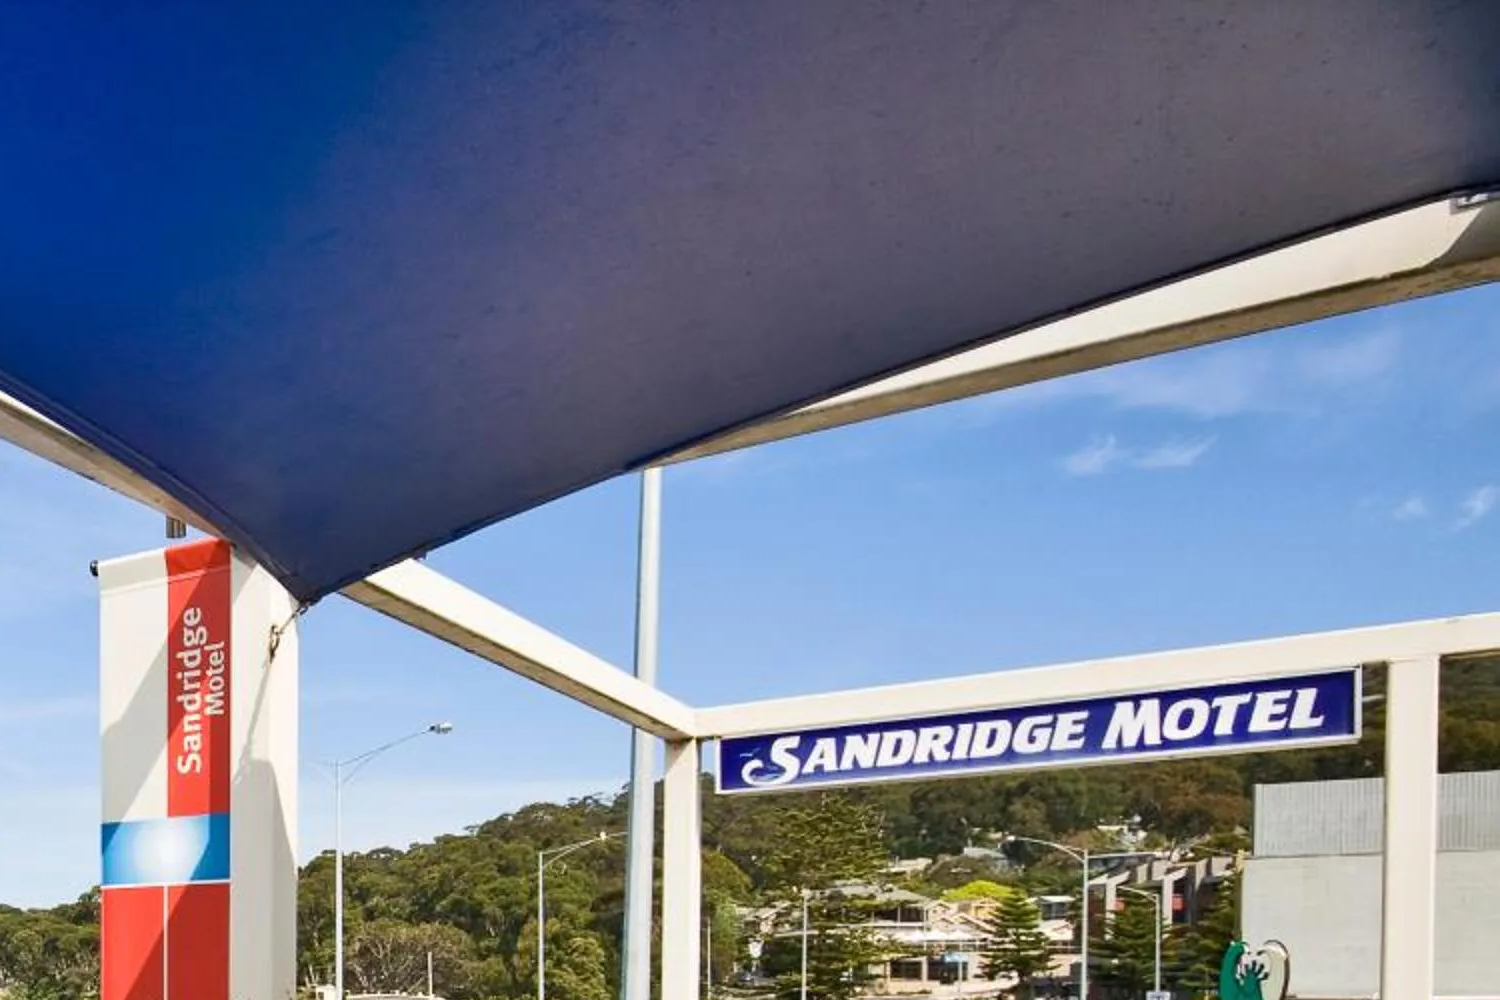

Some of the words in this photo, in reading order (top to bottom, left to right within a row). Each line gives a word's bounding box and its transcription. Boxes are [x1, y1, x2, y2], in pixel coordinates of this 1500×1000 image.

[176, 607, 208, 774] Sandridge
[204, 640, 225, 716] Motel
[741, 710, 1089, 786] SANDRIDGE
[1101, 687, 1325, 749] MOTEL
